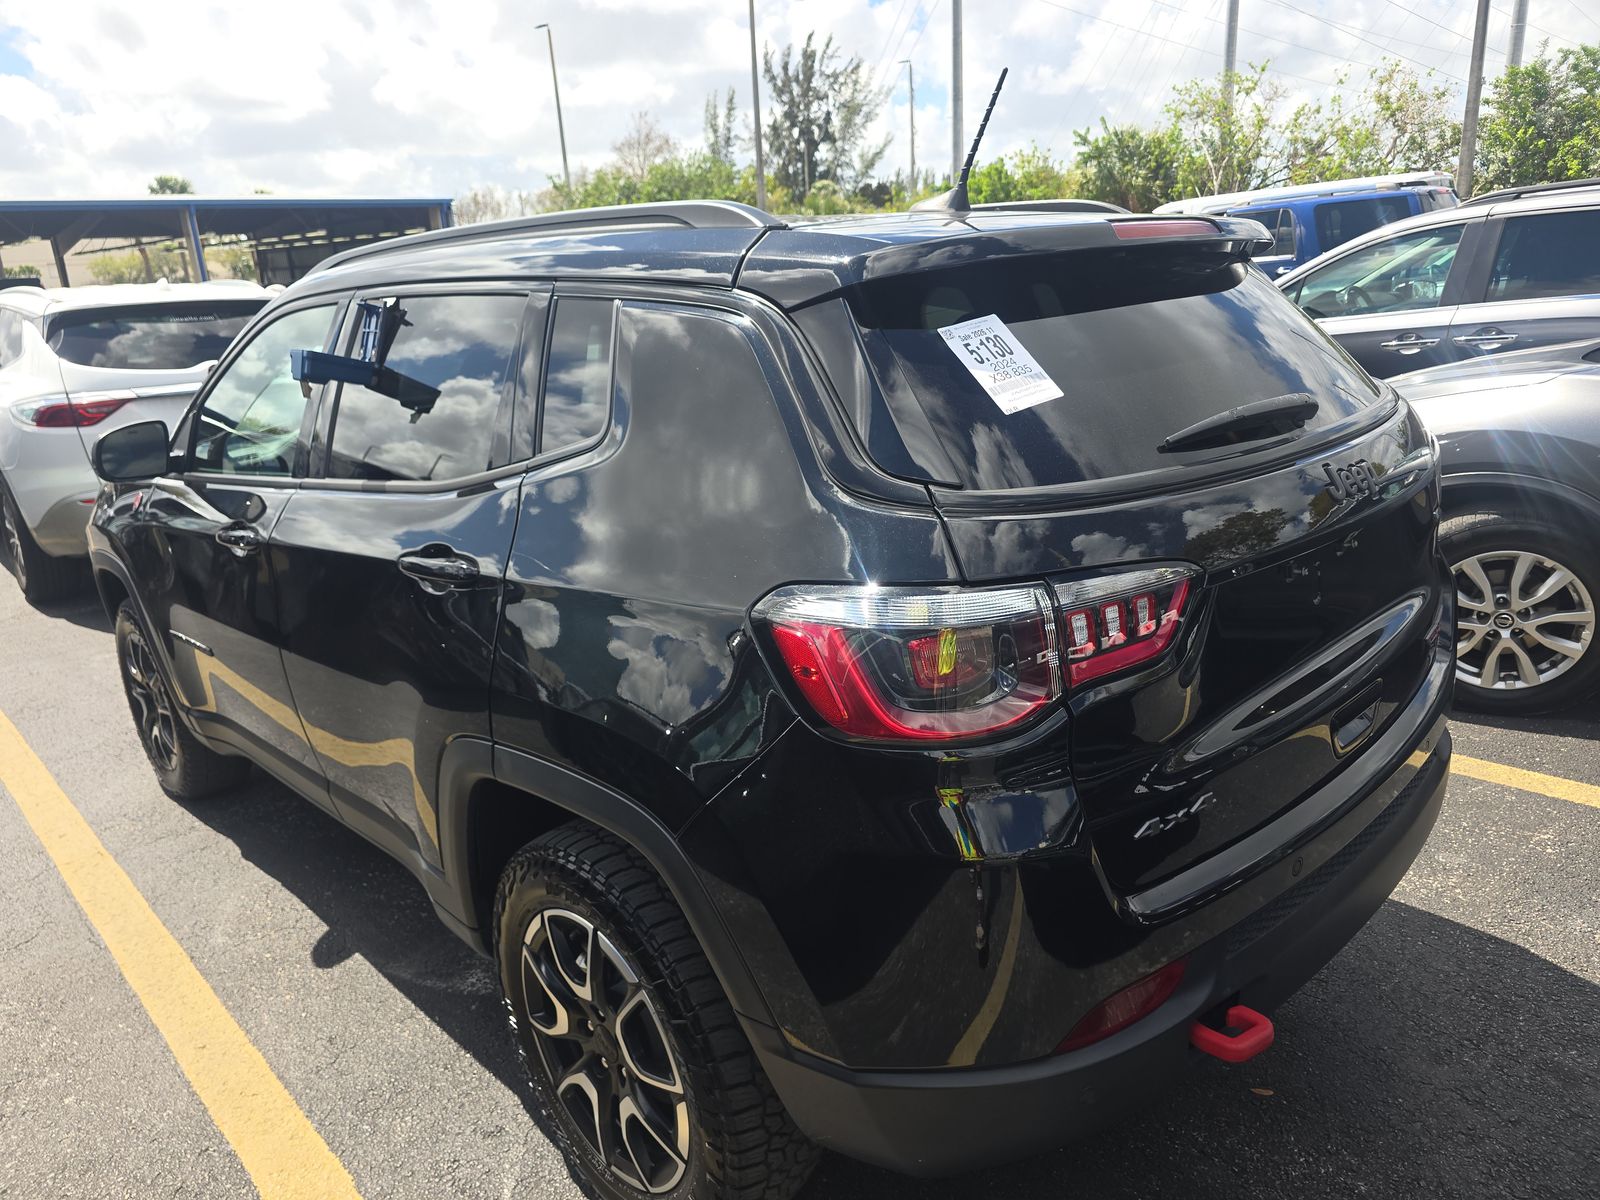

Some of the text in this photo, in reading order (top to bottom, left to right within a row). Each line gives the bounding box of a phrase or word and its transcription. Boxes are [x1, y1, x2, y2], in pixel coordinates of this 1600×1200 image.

[957, 333, 973, 342] Sale
[962, 334, 1014, 365] 5:130
[990, 357, 1017, 372] 2024
[1321, 459, 1380, 501] Jeep
